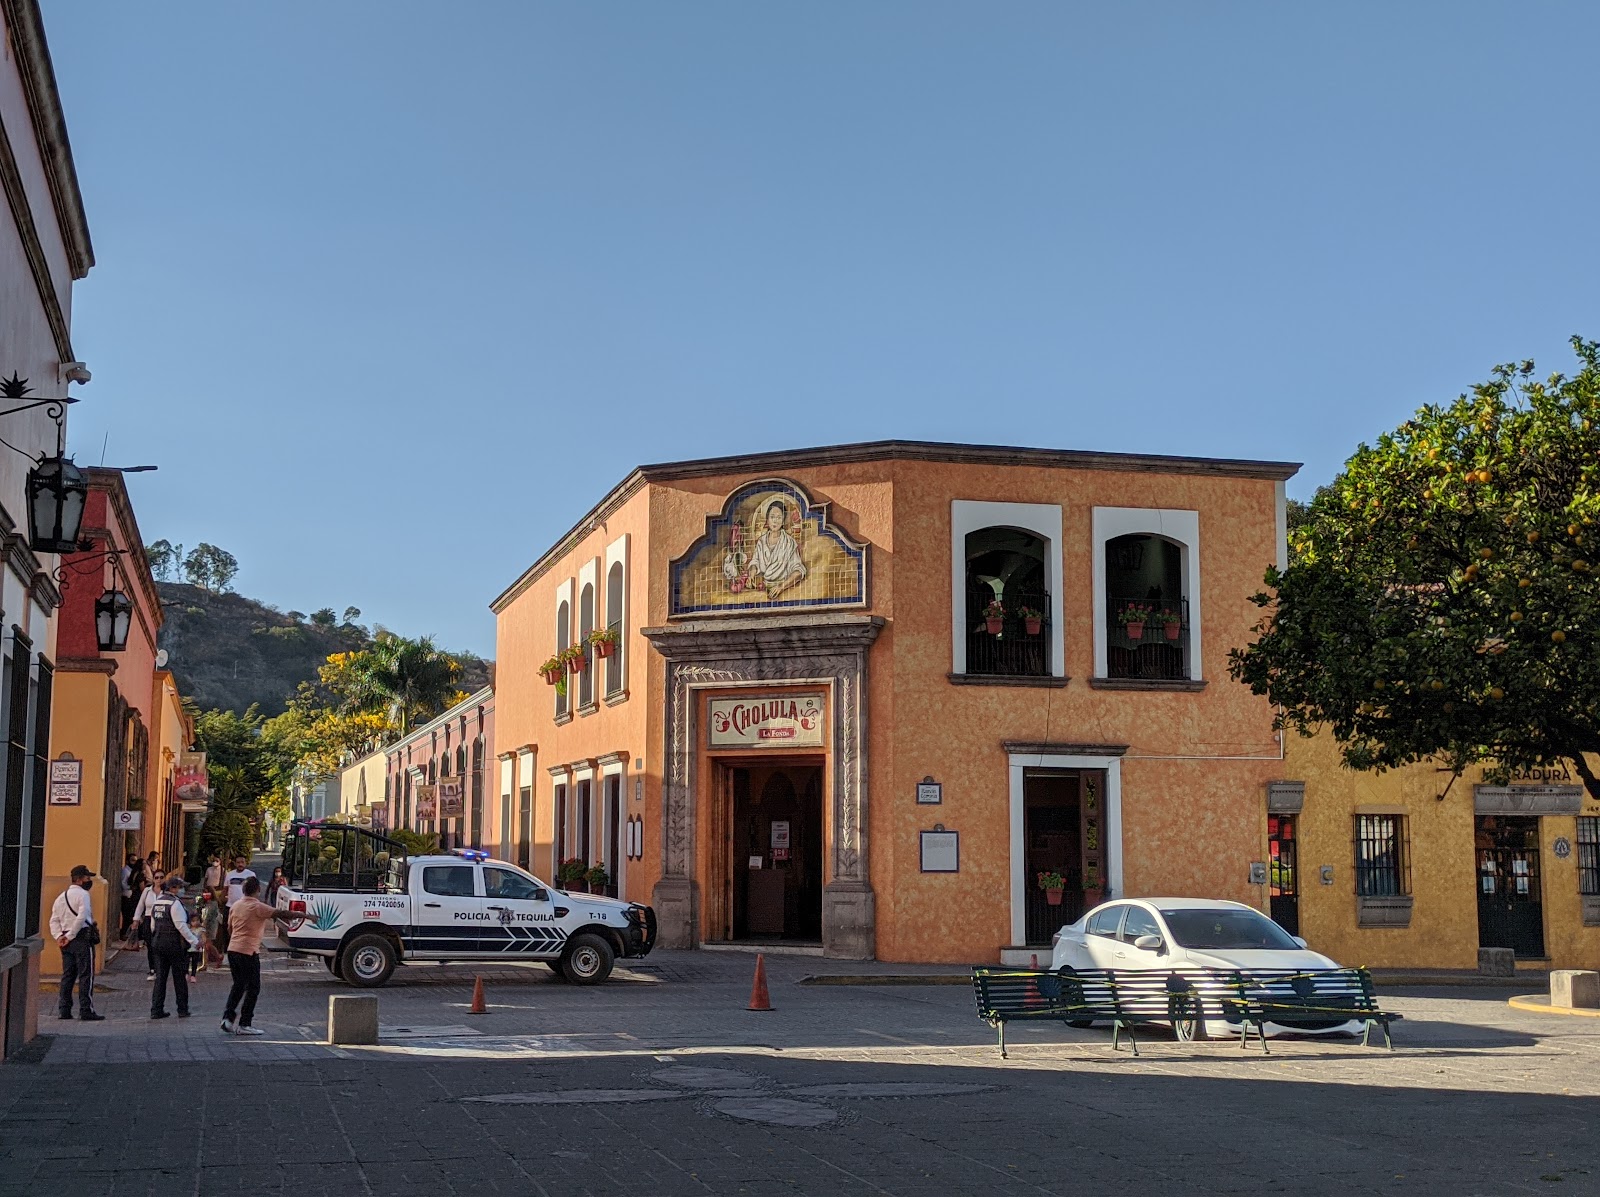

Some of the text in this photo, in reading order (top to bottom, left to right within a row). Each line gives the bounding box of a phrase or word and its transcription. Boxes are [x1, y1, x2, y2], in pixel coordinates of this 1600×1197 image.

[732, 700, 799, 736] CHOLULA
[378, 900, 405, 908] 7420056
[454, 912, 555, 923] POLICIA TEQUILA
[589, 912, 607, 921] T-18
